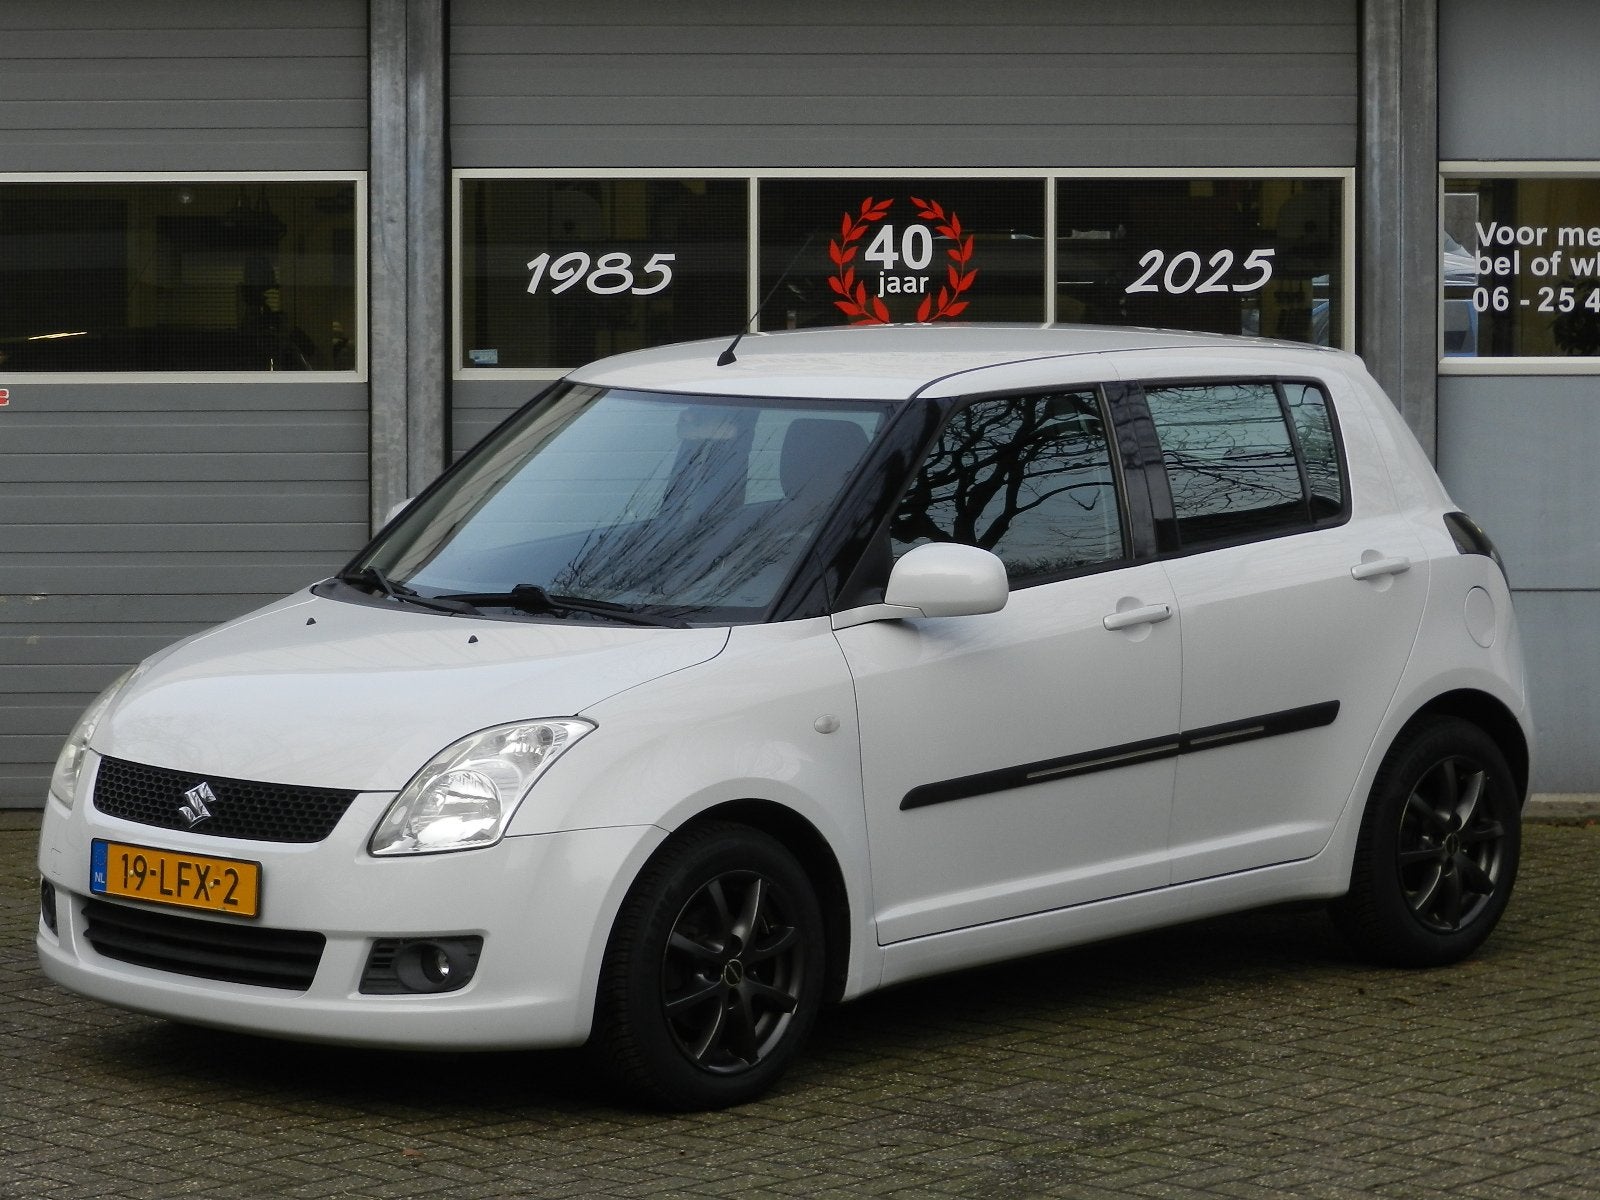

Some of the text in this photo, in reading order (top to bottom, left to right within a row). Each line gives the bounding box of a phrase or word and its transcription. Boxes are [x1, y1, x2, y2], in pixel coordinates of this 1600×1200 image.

[864, 224, 933, 270] 40
[1475, 222, 1547, 247] Voor
[526, 251, 676, 296] 1985
[1124, 248, 1276, 294] 2025
[1475, 251, 1600, 276] bel of w
[877, 271, 930, 298] jaar
[1472, 287, 1509, 312] 06
[1538, 286, 1575, 313] 25
[94, 872, 106, 884] NL
[121, 853, 239, 906] 19-LFX-2
